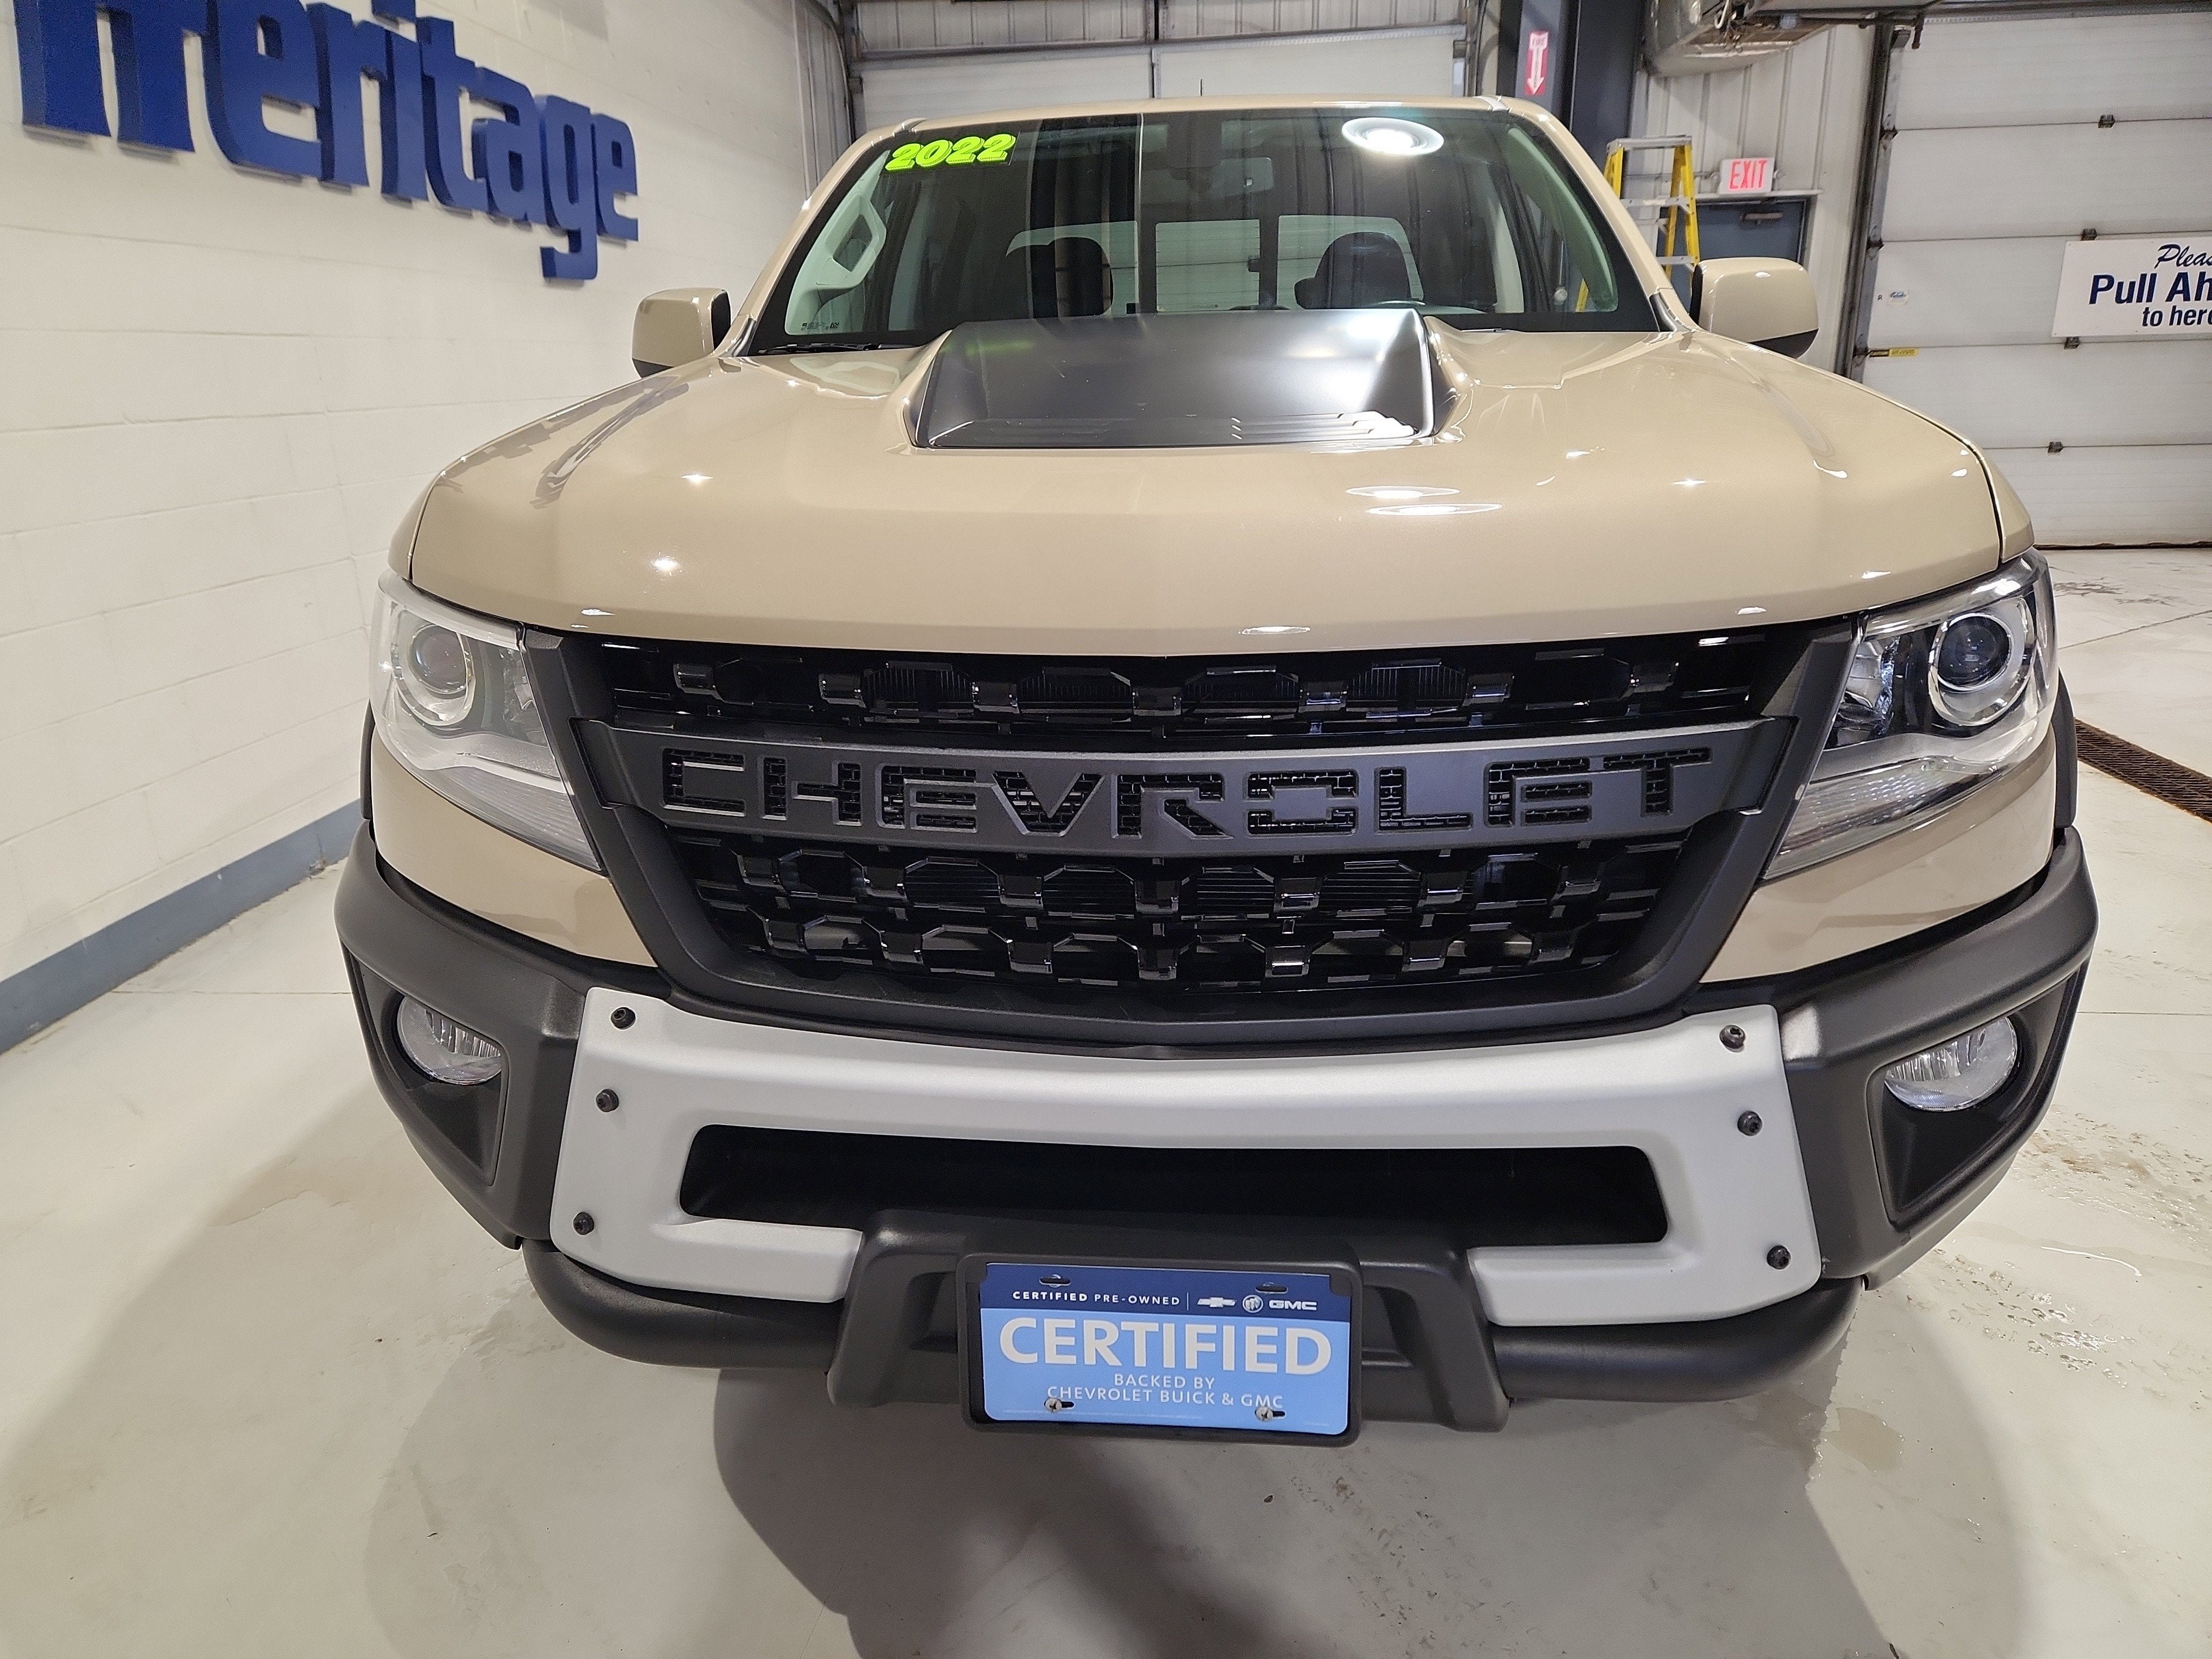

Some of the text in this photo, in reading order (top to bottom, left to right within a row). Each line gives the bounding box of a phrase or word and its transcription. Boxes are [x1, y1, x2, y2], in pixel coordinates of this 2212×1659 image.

[885, 133, 1016, 171] 2022
[1729, 159, 1767, 190] EXIT
[2089, 273, 2157, 305] Pull
[2142, 307, 2163, 327] to
[662, 745, 1713, 838] CHEVROLET
[1012, 1290, 1180, 1305] CERTIFIED PRE-OWNED
[1269, 1300, 1317, 1311] GMC
[999, 1317, 1332, 1375] CERTIFIED
[1114, 1373, 1215, 1390] BACKED BY
[1047, 1385, 1283, 1409] CHEVROLET BUICK & GMC
